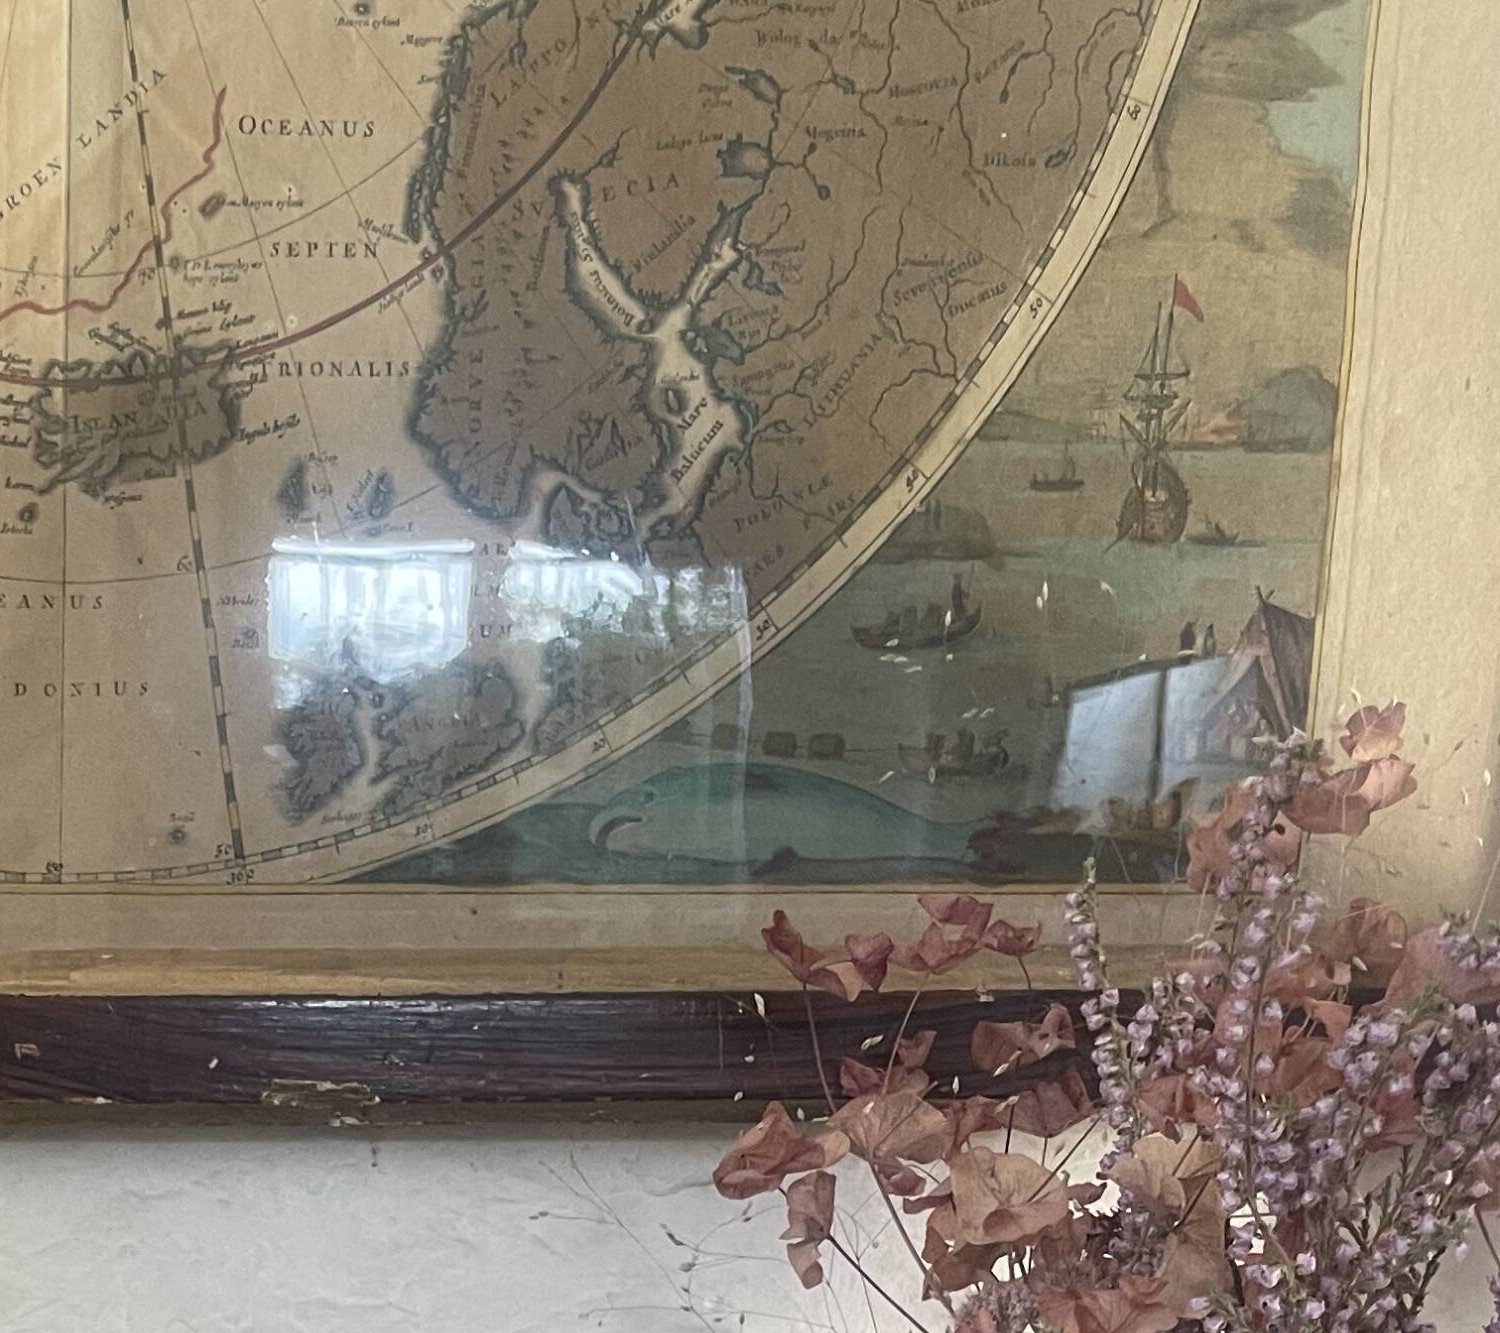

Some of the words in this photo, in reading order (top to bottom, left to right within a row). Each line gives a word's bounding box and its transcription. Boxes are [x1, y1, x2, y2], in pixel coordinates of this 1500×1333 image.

[238, 115, 375, 138] OCEANUS
[270, 241, 377, 258] SEPTEN
[260, 361, 412, 379] TRIONALIS
[677, 397, 709, 434] Mare
